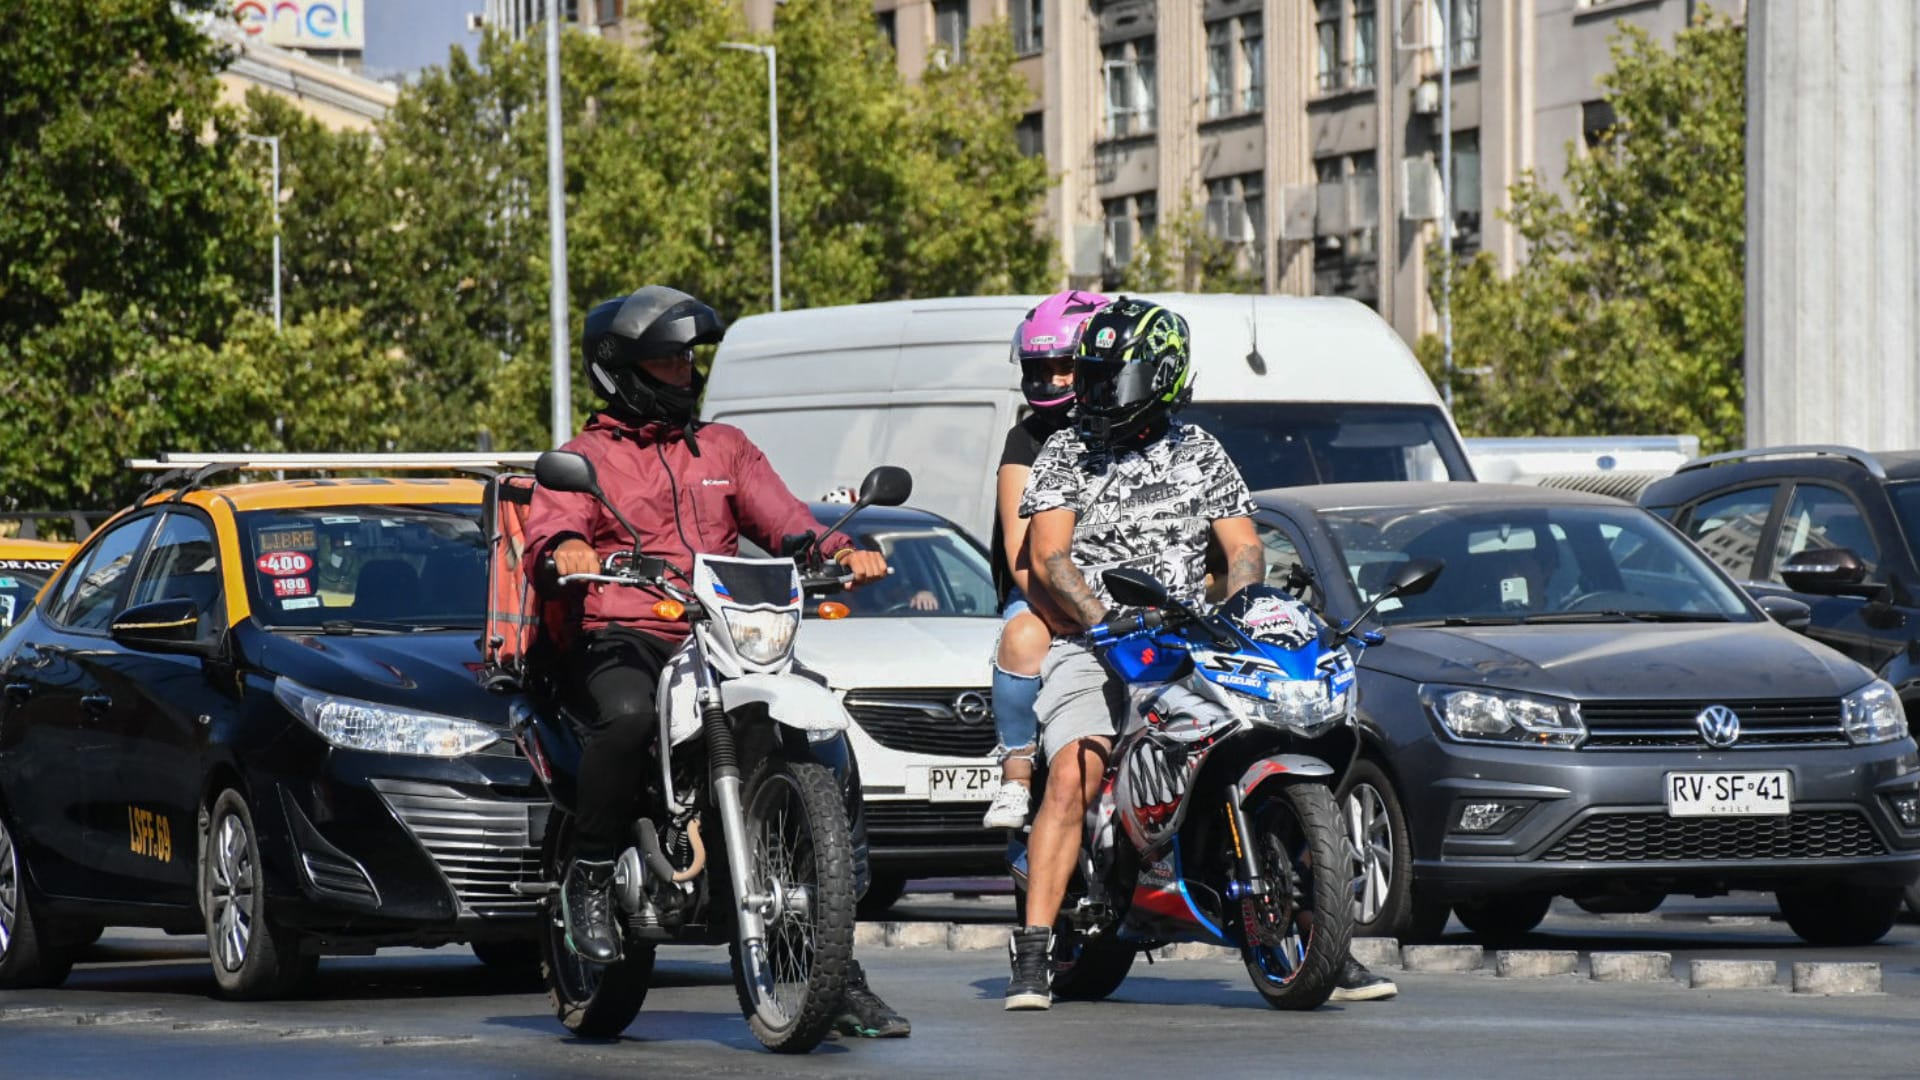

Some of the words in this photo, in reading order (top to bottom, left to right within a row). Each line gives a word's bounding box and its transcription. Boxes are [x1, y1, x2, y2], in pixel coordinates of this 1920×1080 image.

[234, 0, 351, 37] enel
[1137, 485, 1181, 505] ANGELES
[261, 531, 315, 550] LIBRE
[1216, 674, 1262, 688] SUZUKI
